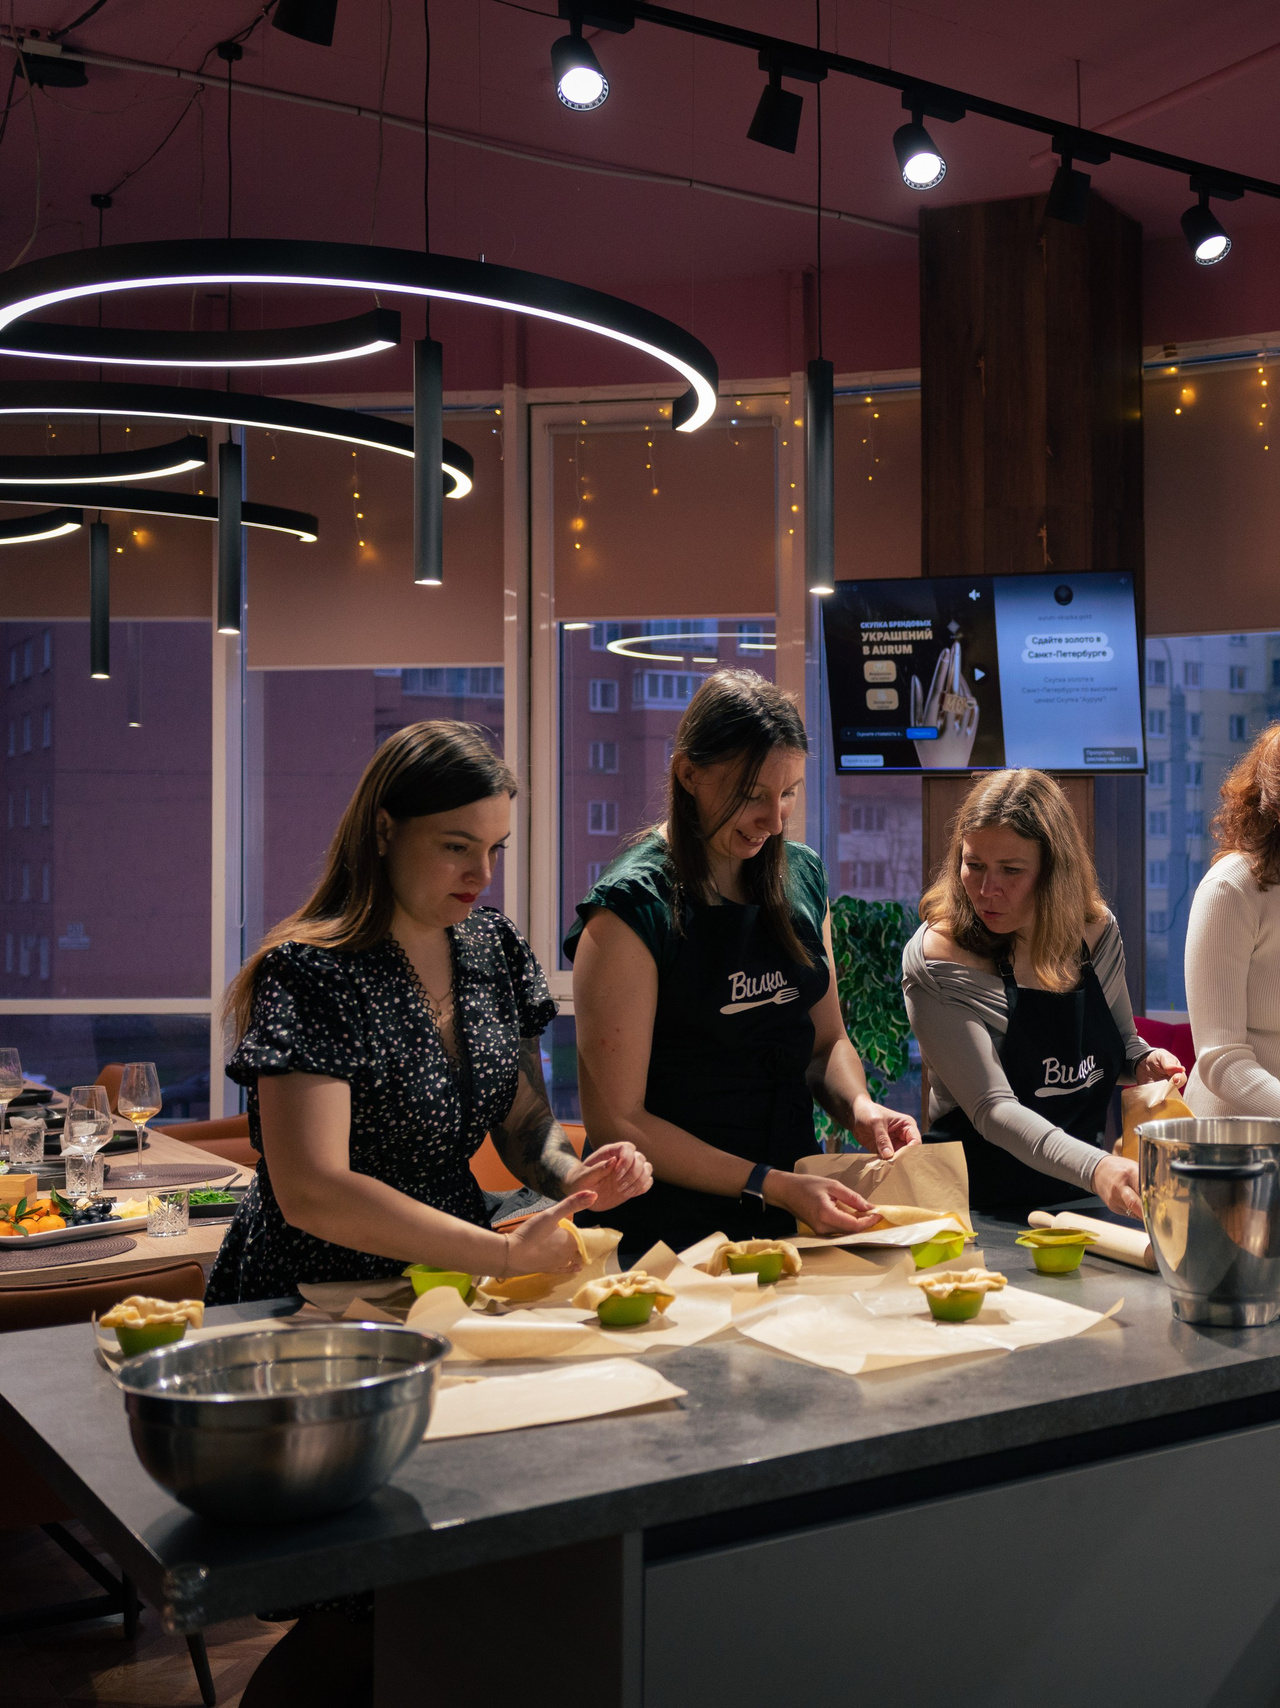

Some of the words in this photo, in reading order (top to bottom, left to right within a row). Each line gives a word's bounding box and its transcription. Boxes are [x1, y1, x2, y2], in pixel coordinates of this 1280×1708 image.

[860, 620, 888, 629] СКУПКА
[889, 619, 932, 628] БРЕНДОВЫХ
[861, 628, 933, 642] УКРАШЕНИЙ
[1031, 635, 1063, 645] Сдайте
[1064, 636, 1095, 644] золото
[862, 645, 870, 655] В
[872, 644, 913, 655] AURUM
[1027, 648, 1107, 659] Санкт-Петербурге
[728, 970, 788, 1002] Вилка
